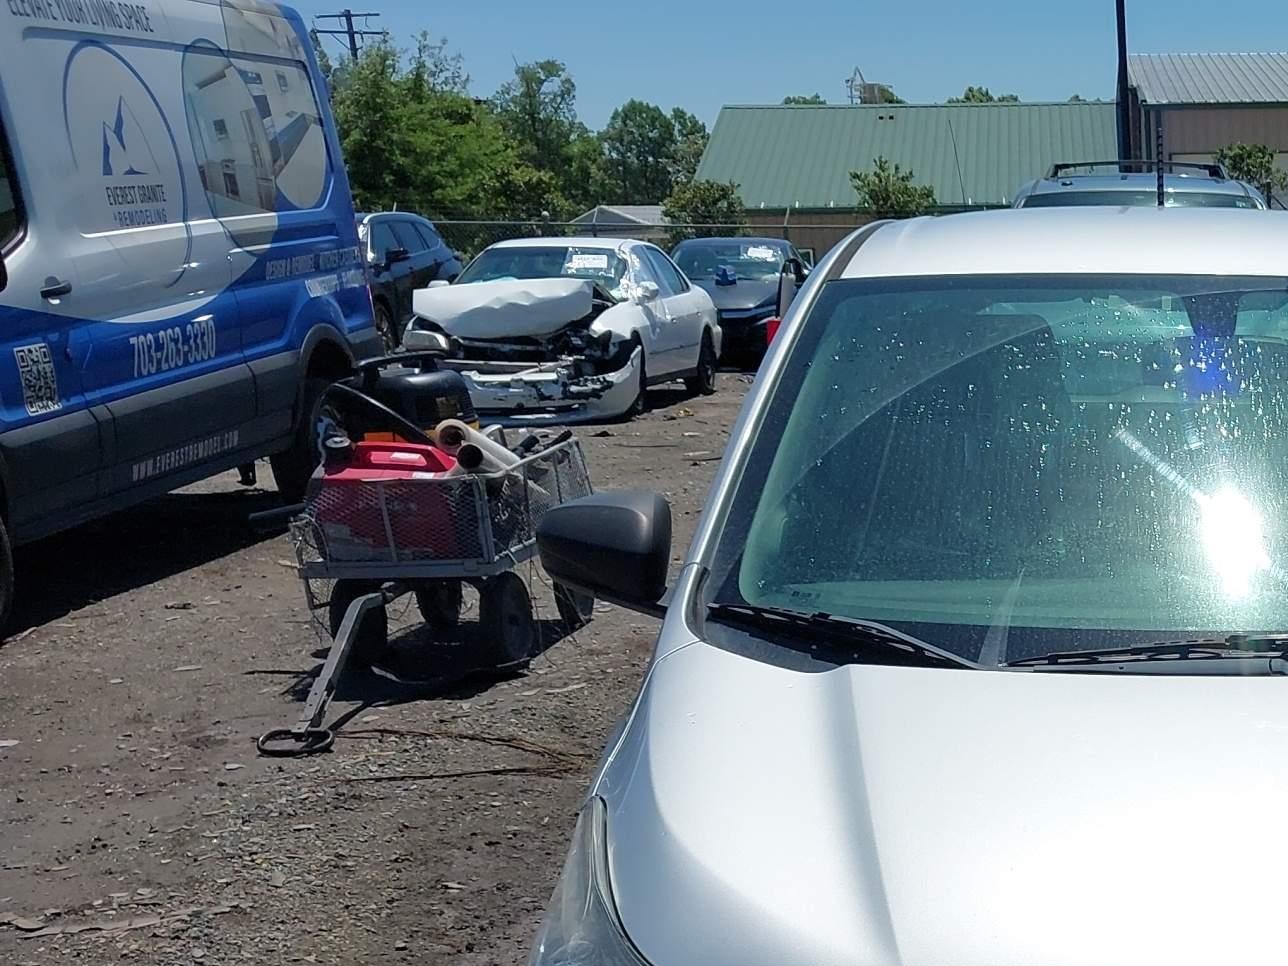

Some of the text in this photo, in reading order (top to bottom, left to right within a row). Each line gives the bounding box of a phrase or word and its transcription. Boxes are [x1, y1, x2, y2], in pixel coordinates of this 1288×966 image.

[117, 2, 155, 32] SPACE
[106, 184, 167, 206] EVEREST GRANITE
[129, 319, 216, 379] 703-263-3330
